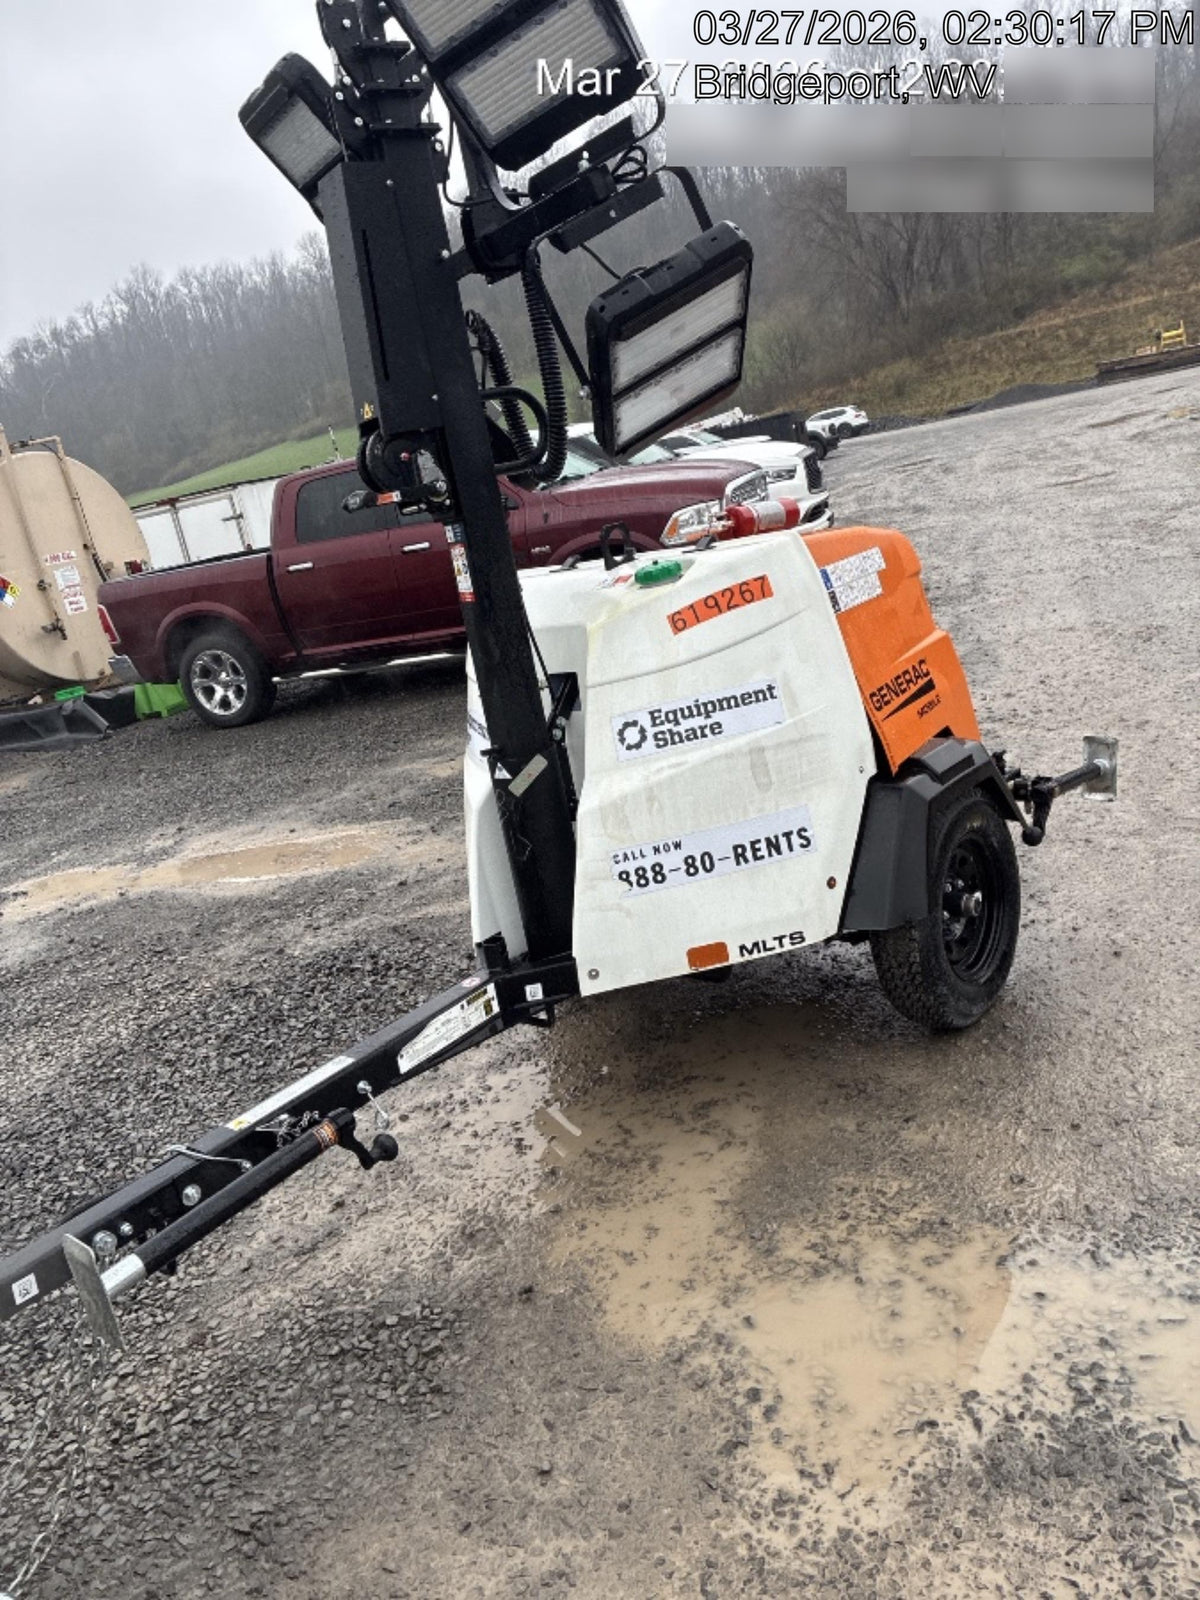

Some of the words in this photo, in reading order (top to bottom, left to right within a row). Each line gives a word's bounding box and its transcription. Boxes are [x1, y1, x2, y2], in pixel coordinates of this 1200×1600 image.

[671, 575, 770, 633] 619267
[869, 658, 931, 712] GENERAC
[648, 683, 778, 728] Equipment
[652, 720, 724, 750] Share
[612, 848, 647, 865] CALL
[652, 839, 682, 856] NOW
[738, 930, 806, 958] MLTS
